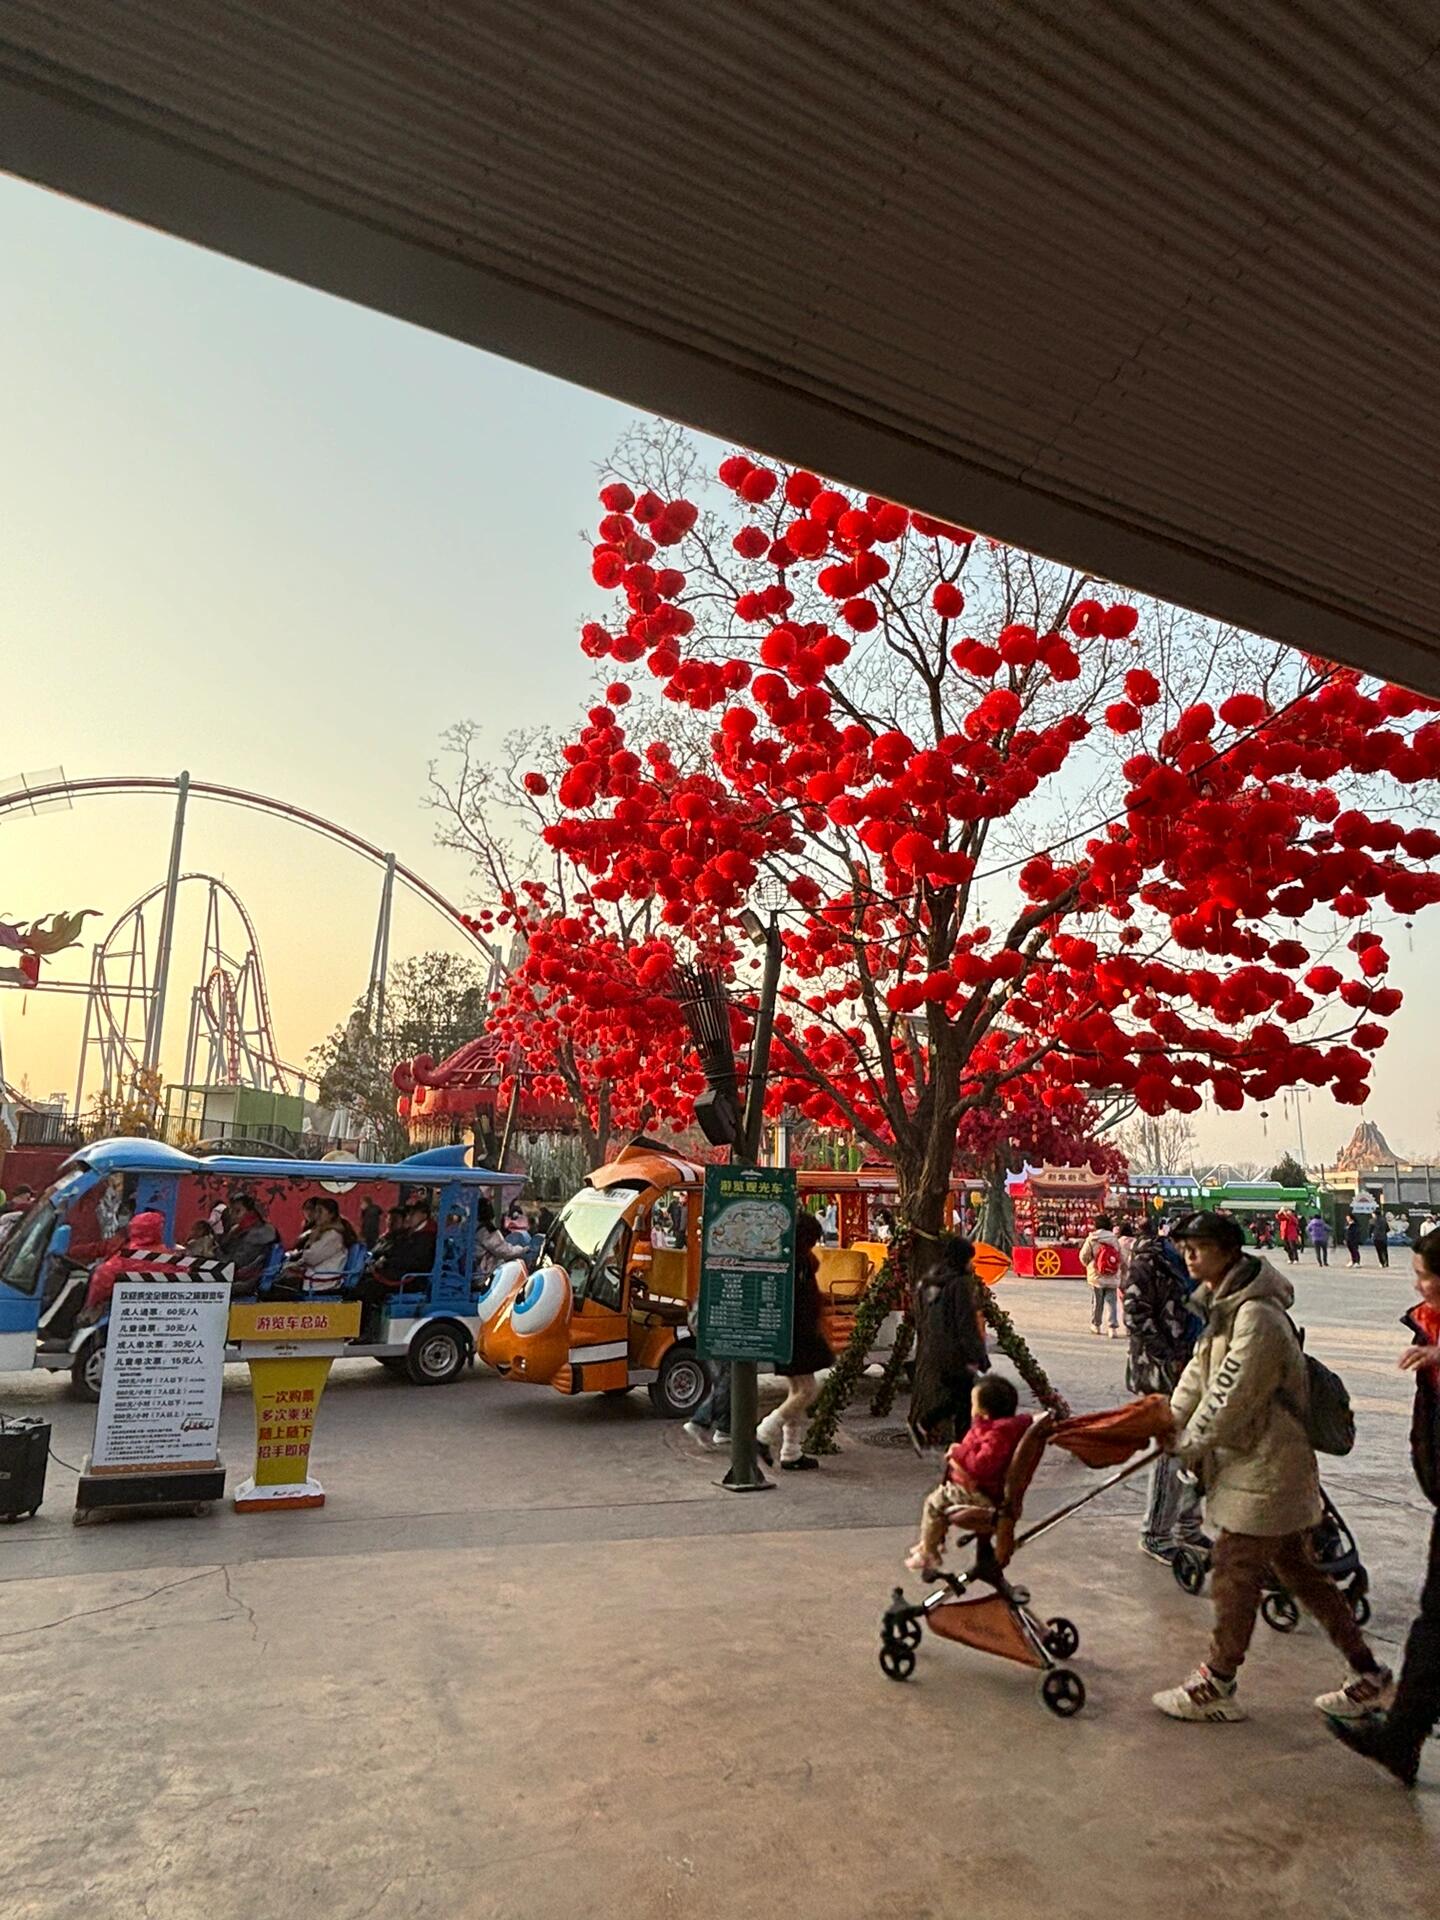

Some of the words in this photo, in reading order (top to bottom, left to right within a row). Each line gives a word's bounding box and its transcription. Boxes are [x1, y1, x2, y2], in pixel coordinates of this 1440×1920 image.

[720, 1180, 784, 1194] 游览观光车
[257, 1315, 328, 1331] 游览车总站
[262, 1389, 315, 1404] 一次购票
[261, 1407, 313, 1422] 多次乘坐
[259, 1425, 312, 1440] 随上随下
[257, 1444, 310, 1460] 招手即停
